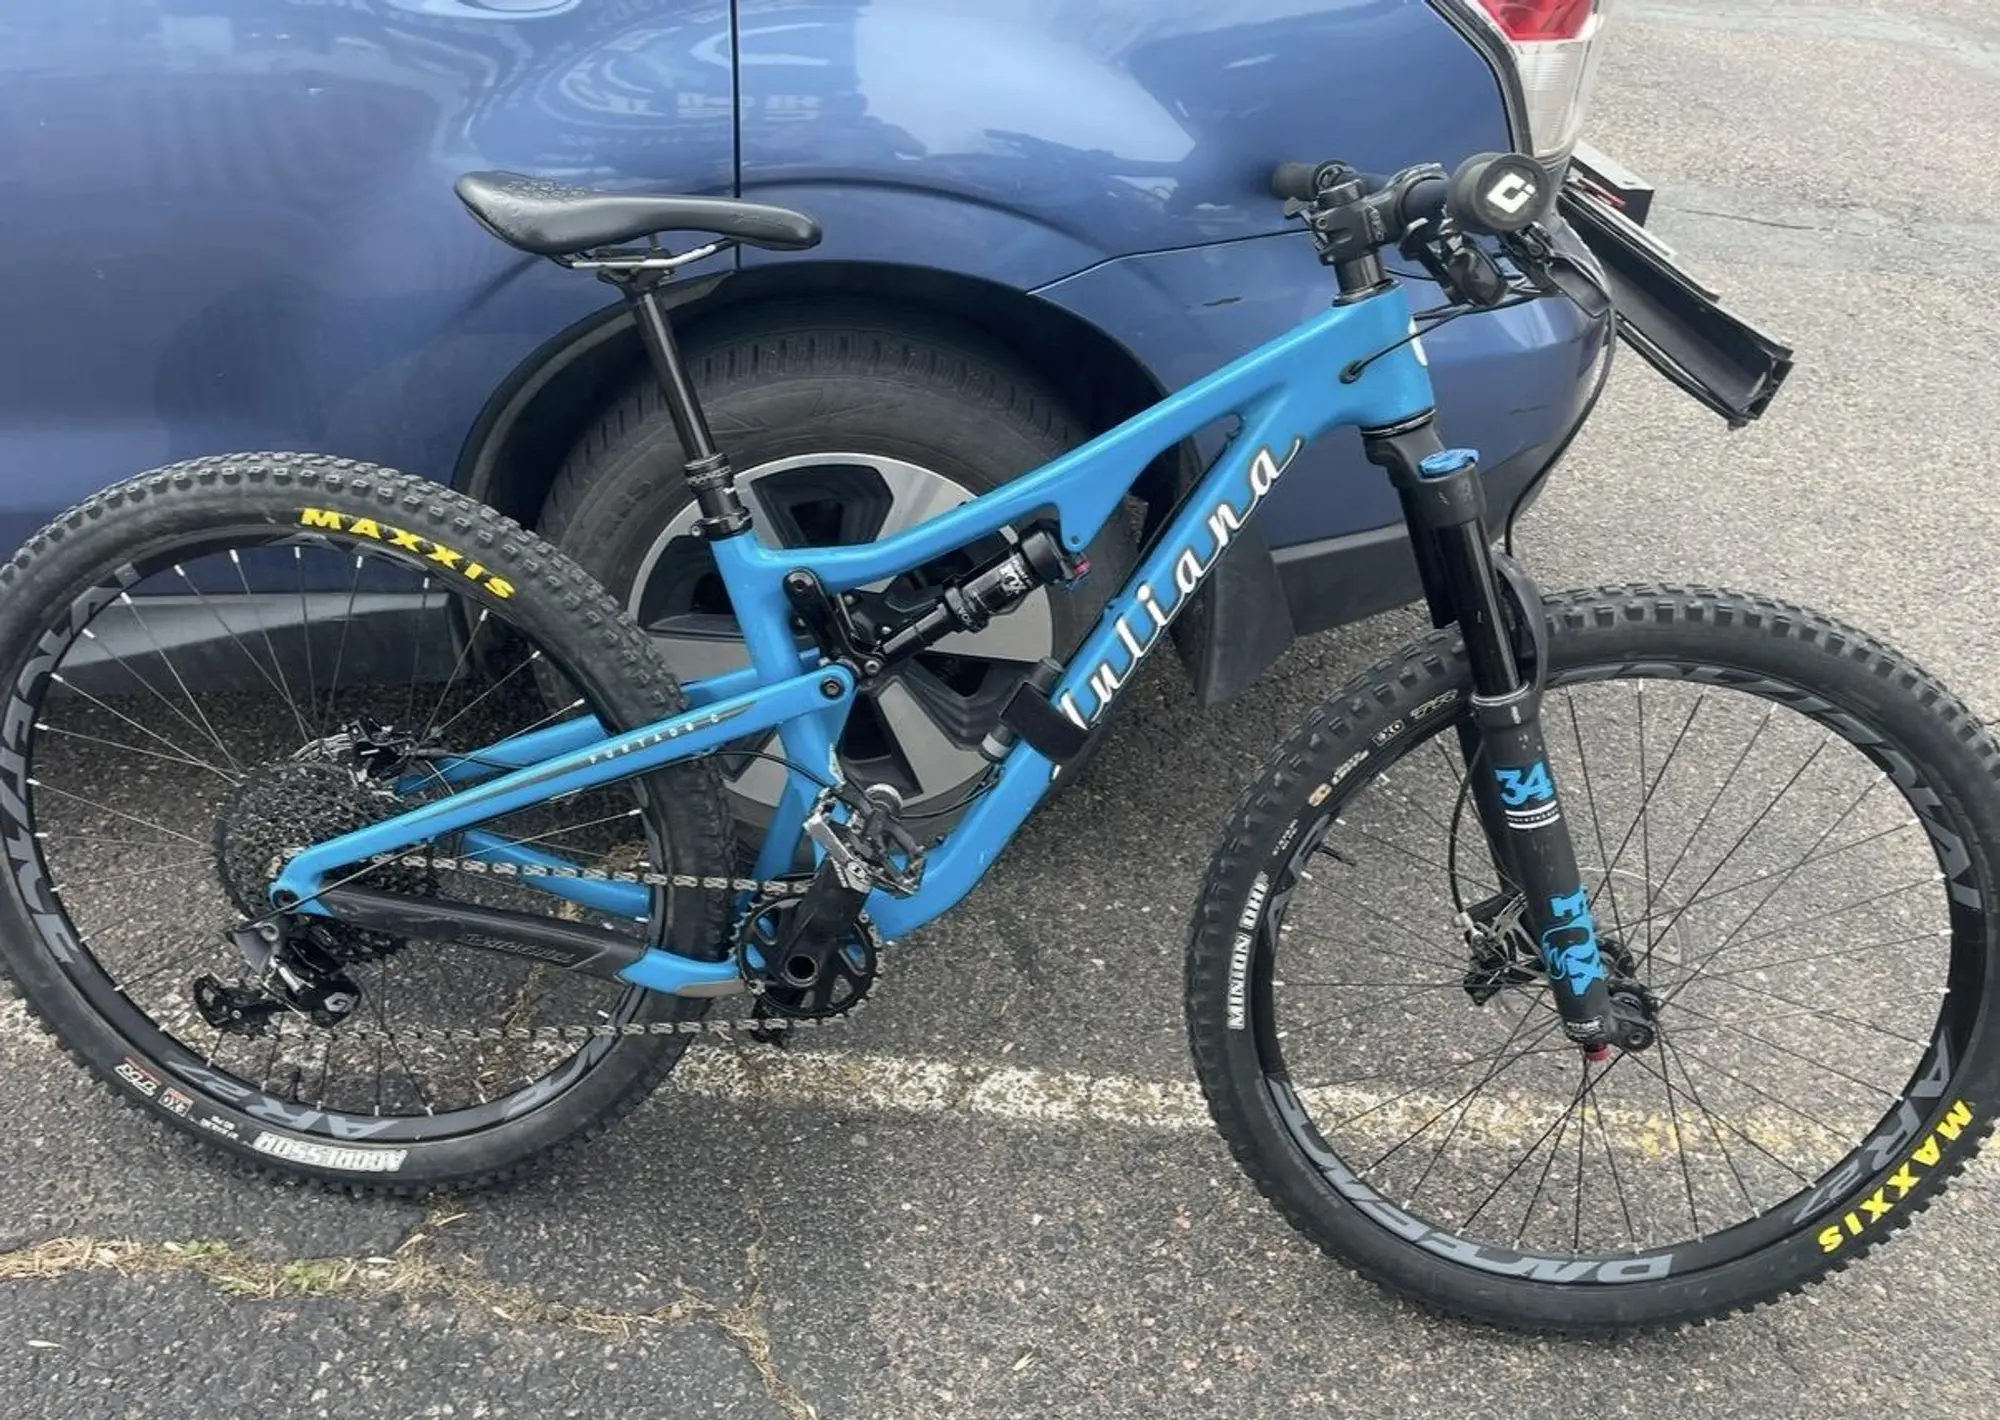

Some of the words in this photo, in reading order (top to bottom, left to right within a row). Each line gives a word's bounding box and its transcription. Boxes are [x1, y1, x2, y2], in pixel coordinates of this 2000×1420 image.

[301, 507, 516, 600] MAXXIS
[1494, 760, 1554, 806] 34
[1226, 930, 1253, 1029] MINION
[1541, 885, 1610, 996] FOX
[1817, 1099, 1974, 1254] MAXXIS
